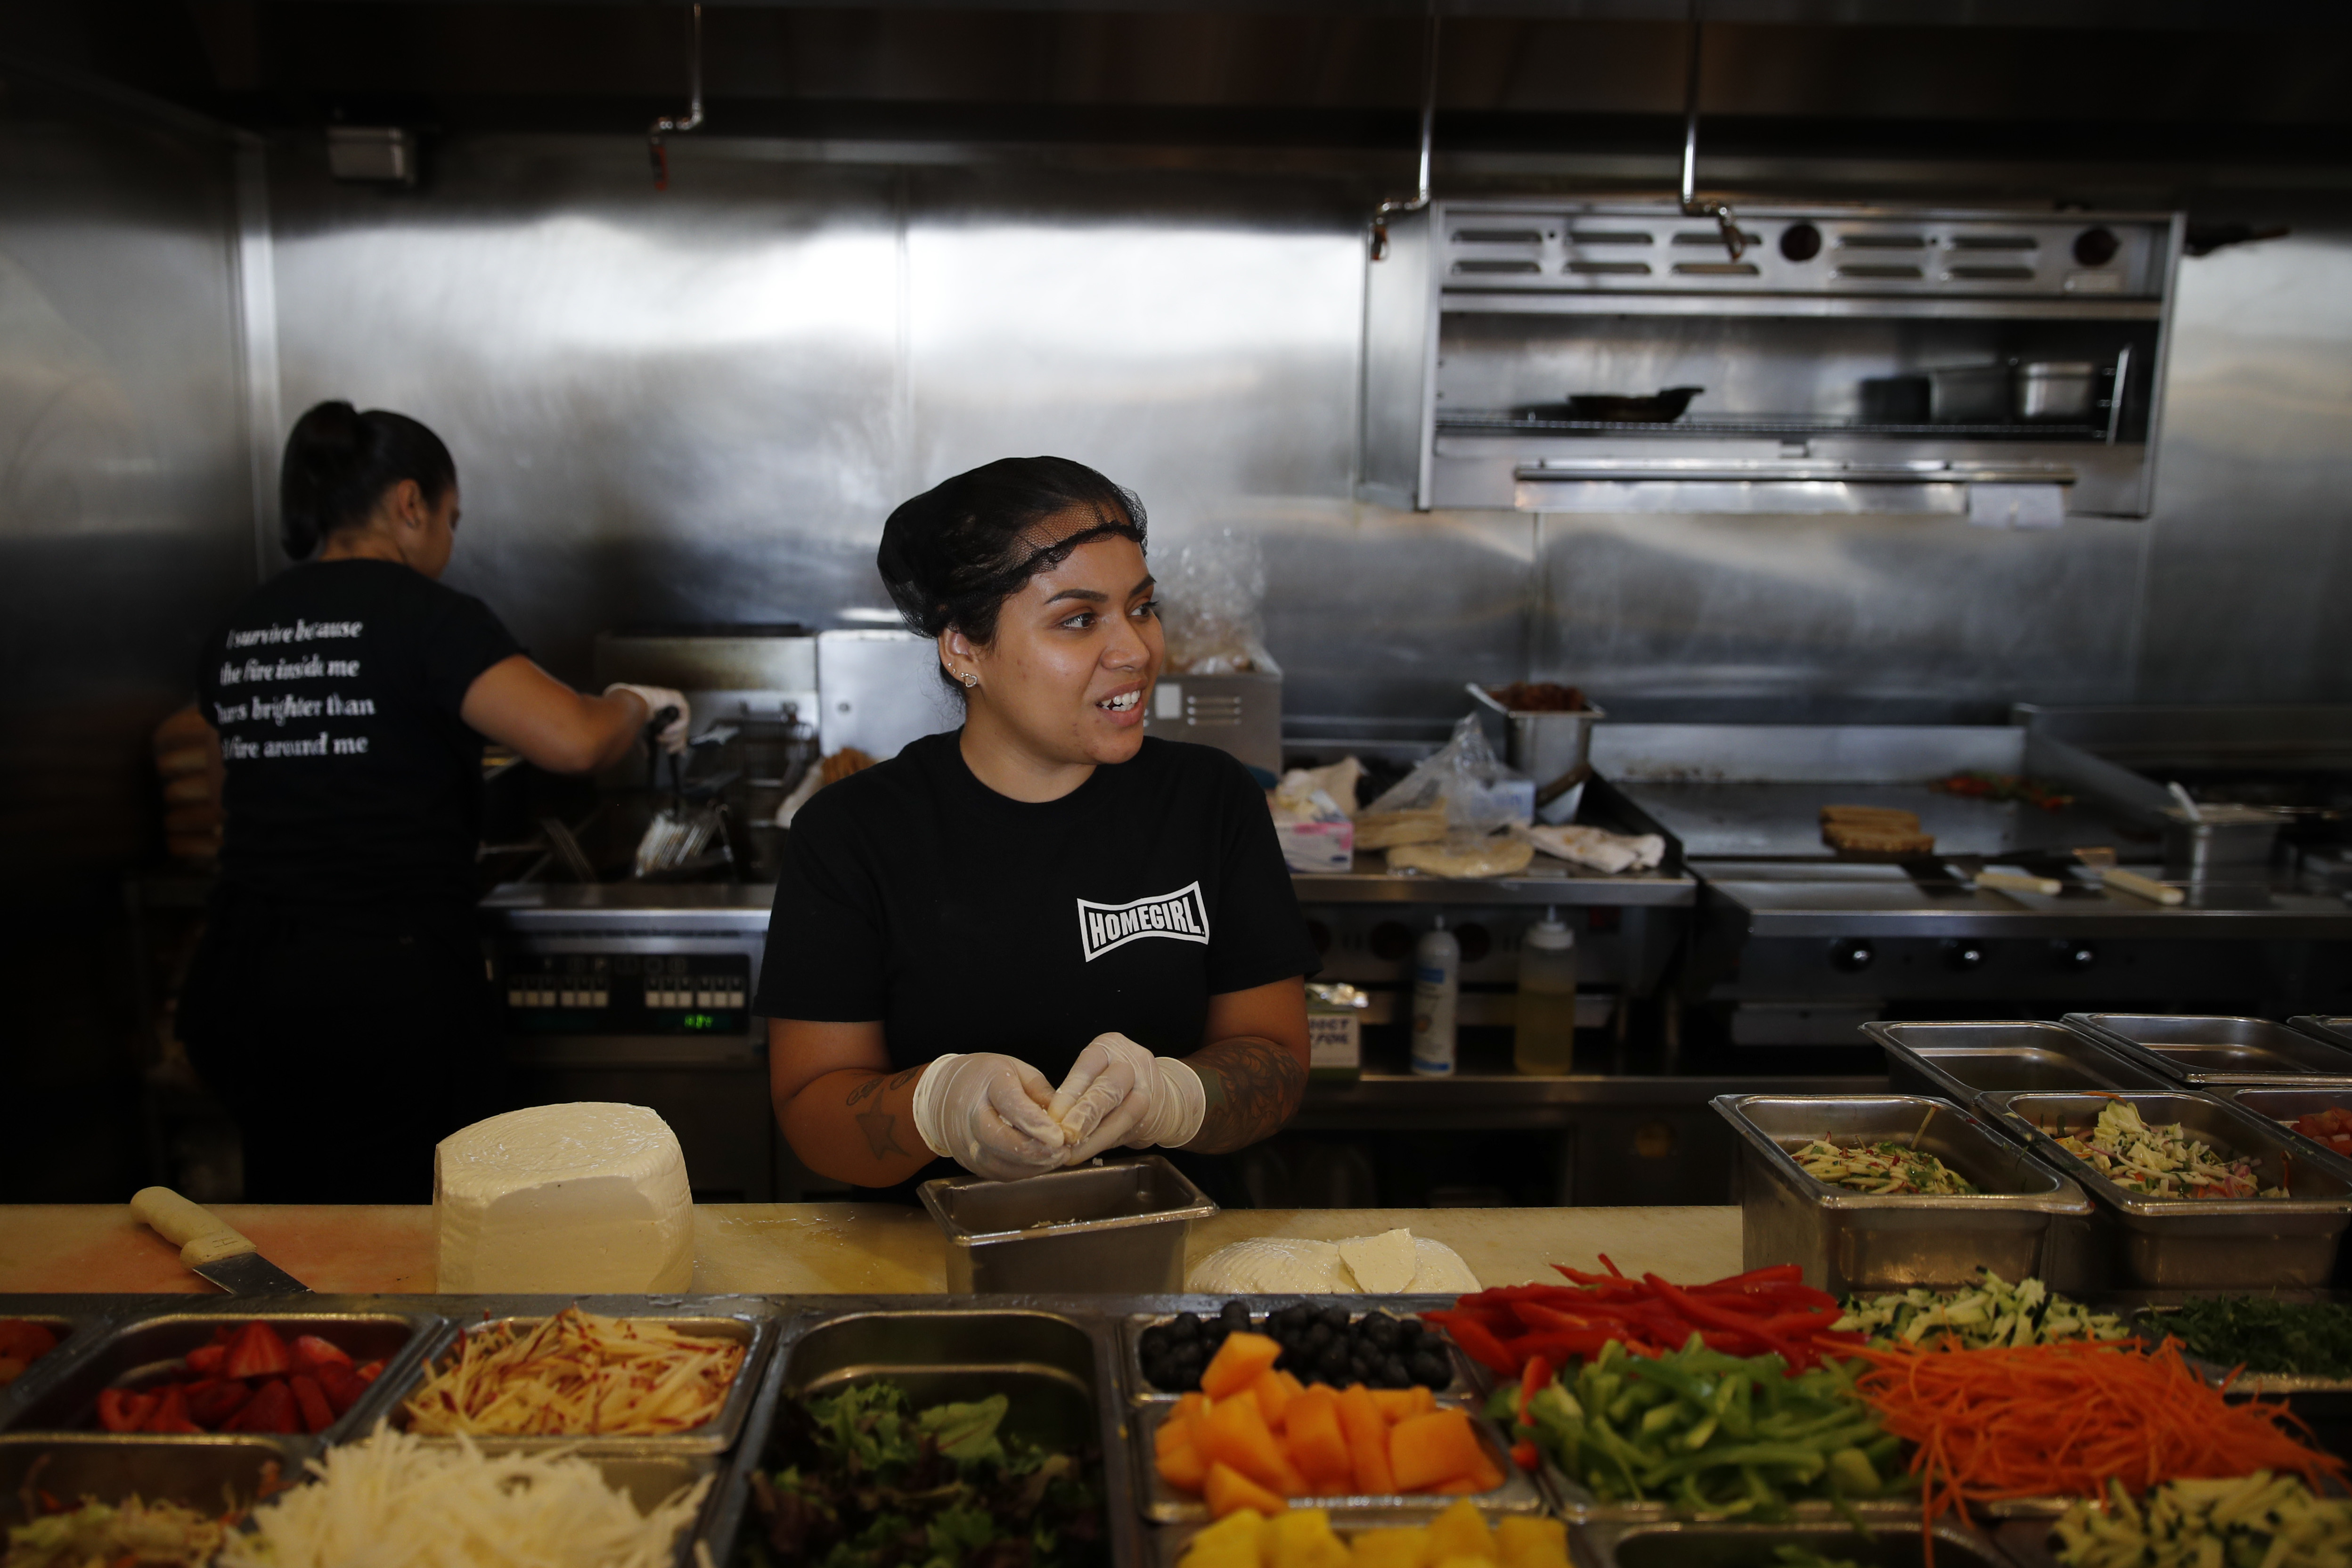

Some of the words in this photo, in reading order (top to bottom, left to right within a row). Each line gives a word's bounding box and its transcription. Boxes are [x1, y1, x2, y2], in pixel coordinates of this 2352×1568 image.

[234, 622, 294, 648] survive
[294, 618, 363, 642] because
[220, 662, 242, 686] the
[243, 658, 274, 682] fire
[327, 660, 360, 677] me
[251, 694, 323, 727] brighter
[326, 692, 376, 716] than
[263, 731, 328, 758] around
[333, 736, 368, 754] me
[1088, 896, 1201, 949] HOMEGIRL
